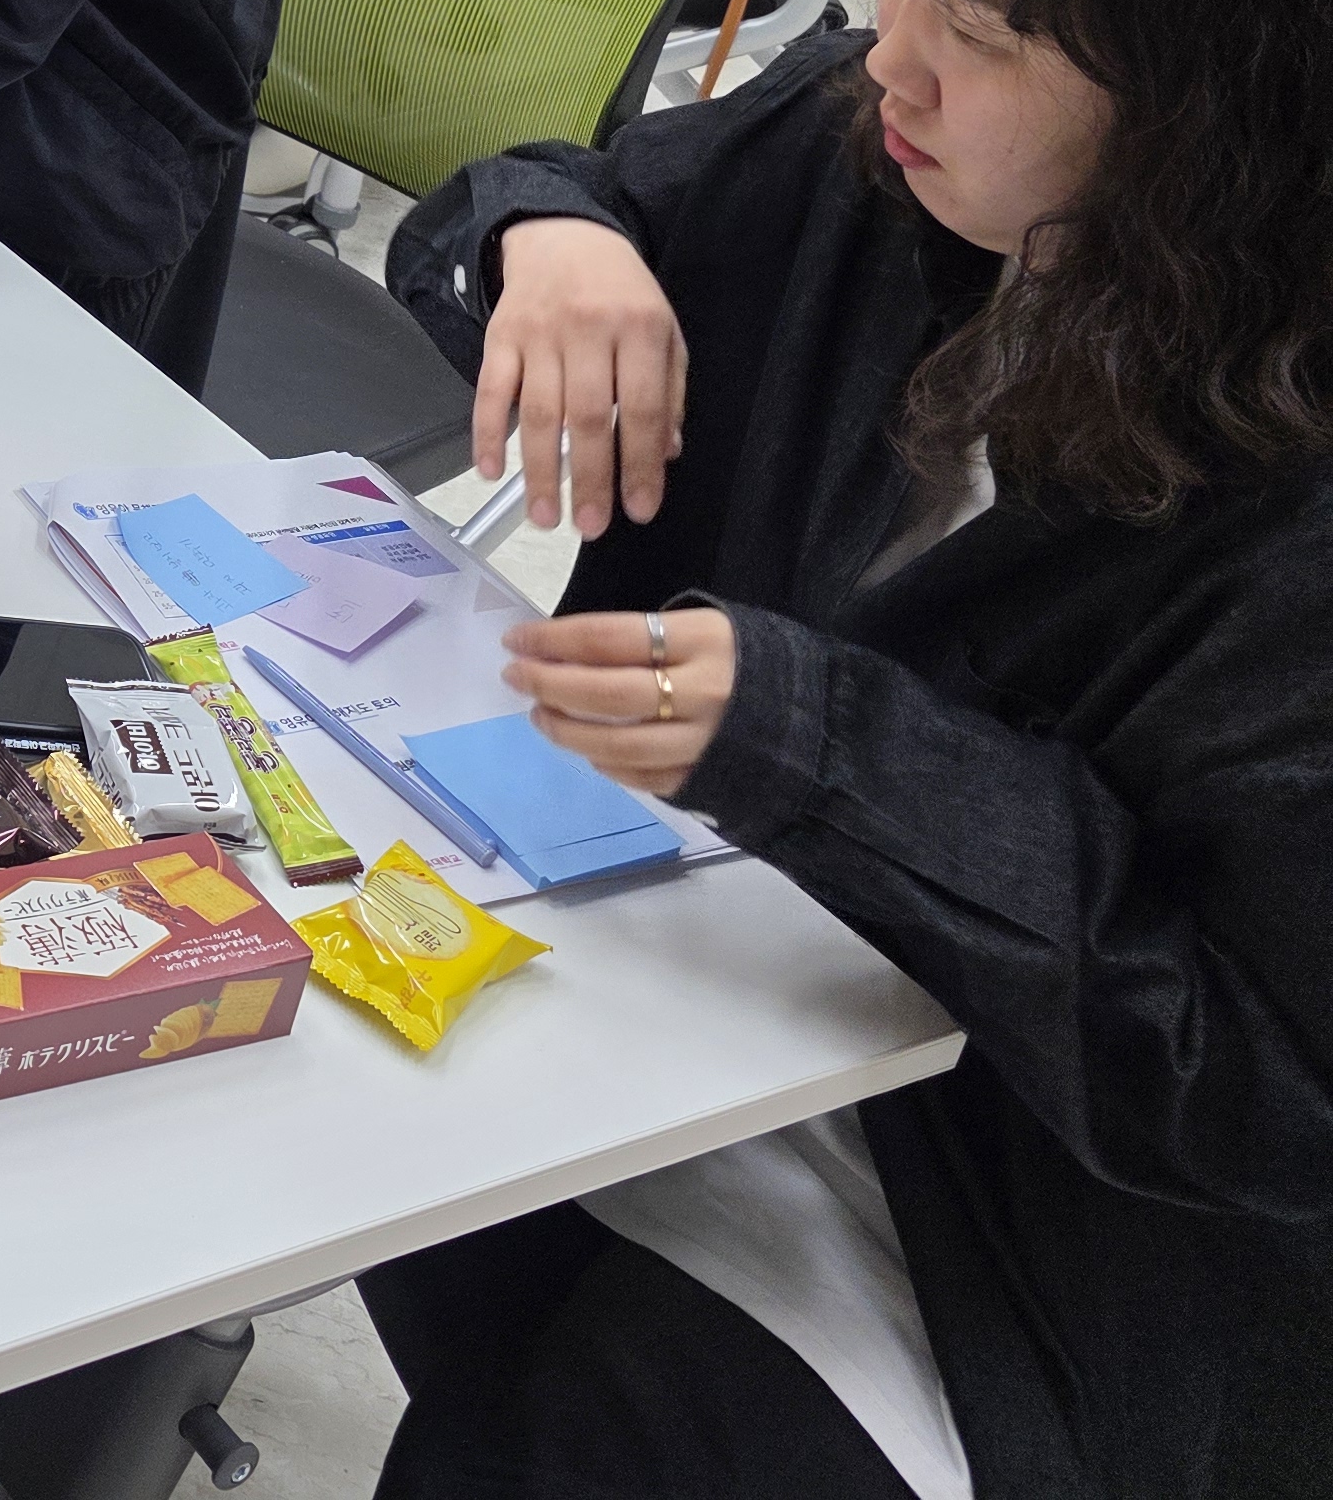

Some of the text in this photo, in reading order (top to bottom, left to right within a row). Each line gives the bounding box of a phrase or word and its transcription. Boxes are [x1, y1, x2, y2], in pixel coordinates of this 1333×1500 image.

[371, 697, 400, 710] 토의
[126, 722, 161, 773] 아이비
[172, 748, 221, 814] 아몬드
[3, 889, 93, 915] ポテクリスピー
[16, 905, 141, 967] 極薄
[17, 1031, 136, 1071] ポテクリスピー
